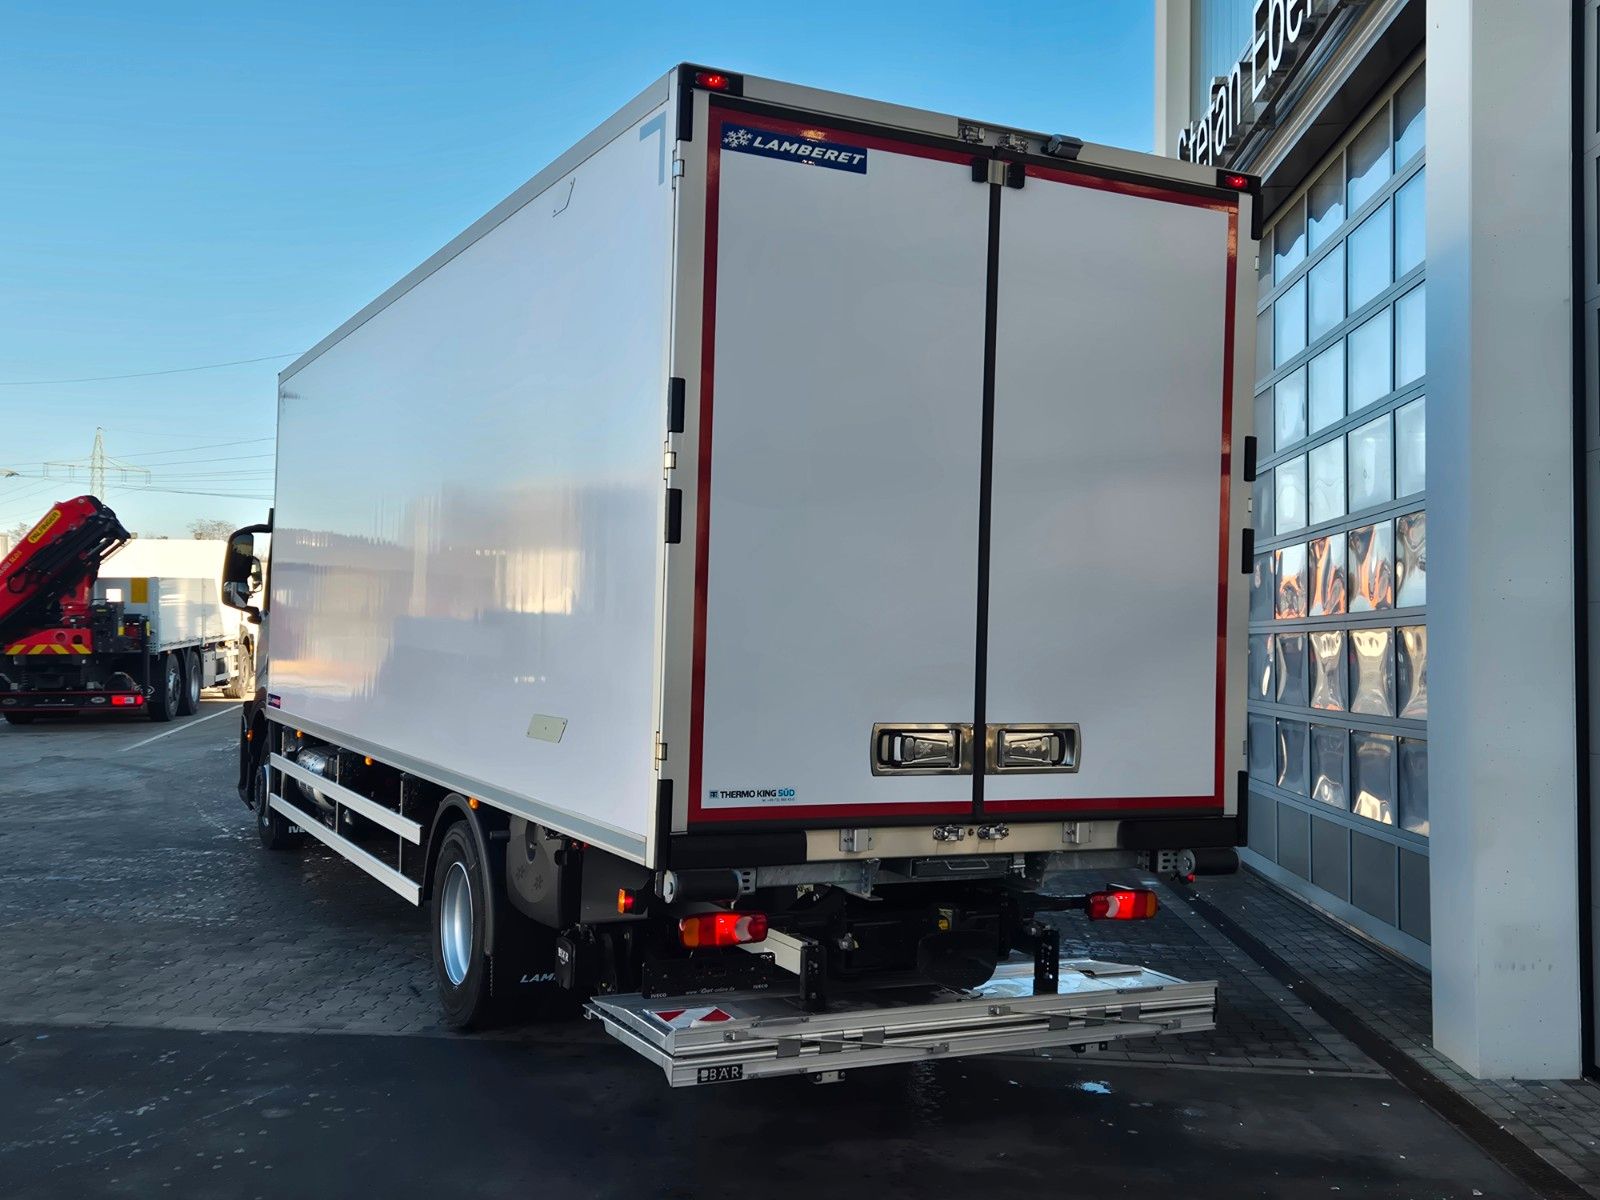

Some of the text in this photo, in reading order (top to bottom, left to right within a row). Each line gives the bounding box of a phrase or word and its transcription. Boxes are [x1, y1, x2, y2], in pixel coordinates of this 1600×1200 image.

[1252, 0, 1312, 104] Ebe
[752, 136, 866, 165] LAMBERET
[720, 787, 795, 799] THERMO KING SÜD
[520, 972, 556, 983] LAM
[709, 1066, 740, 1081] BÄR
